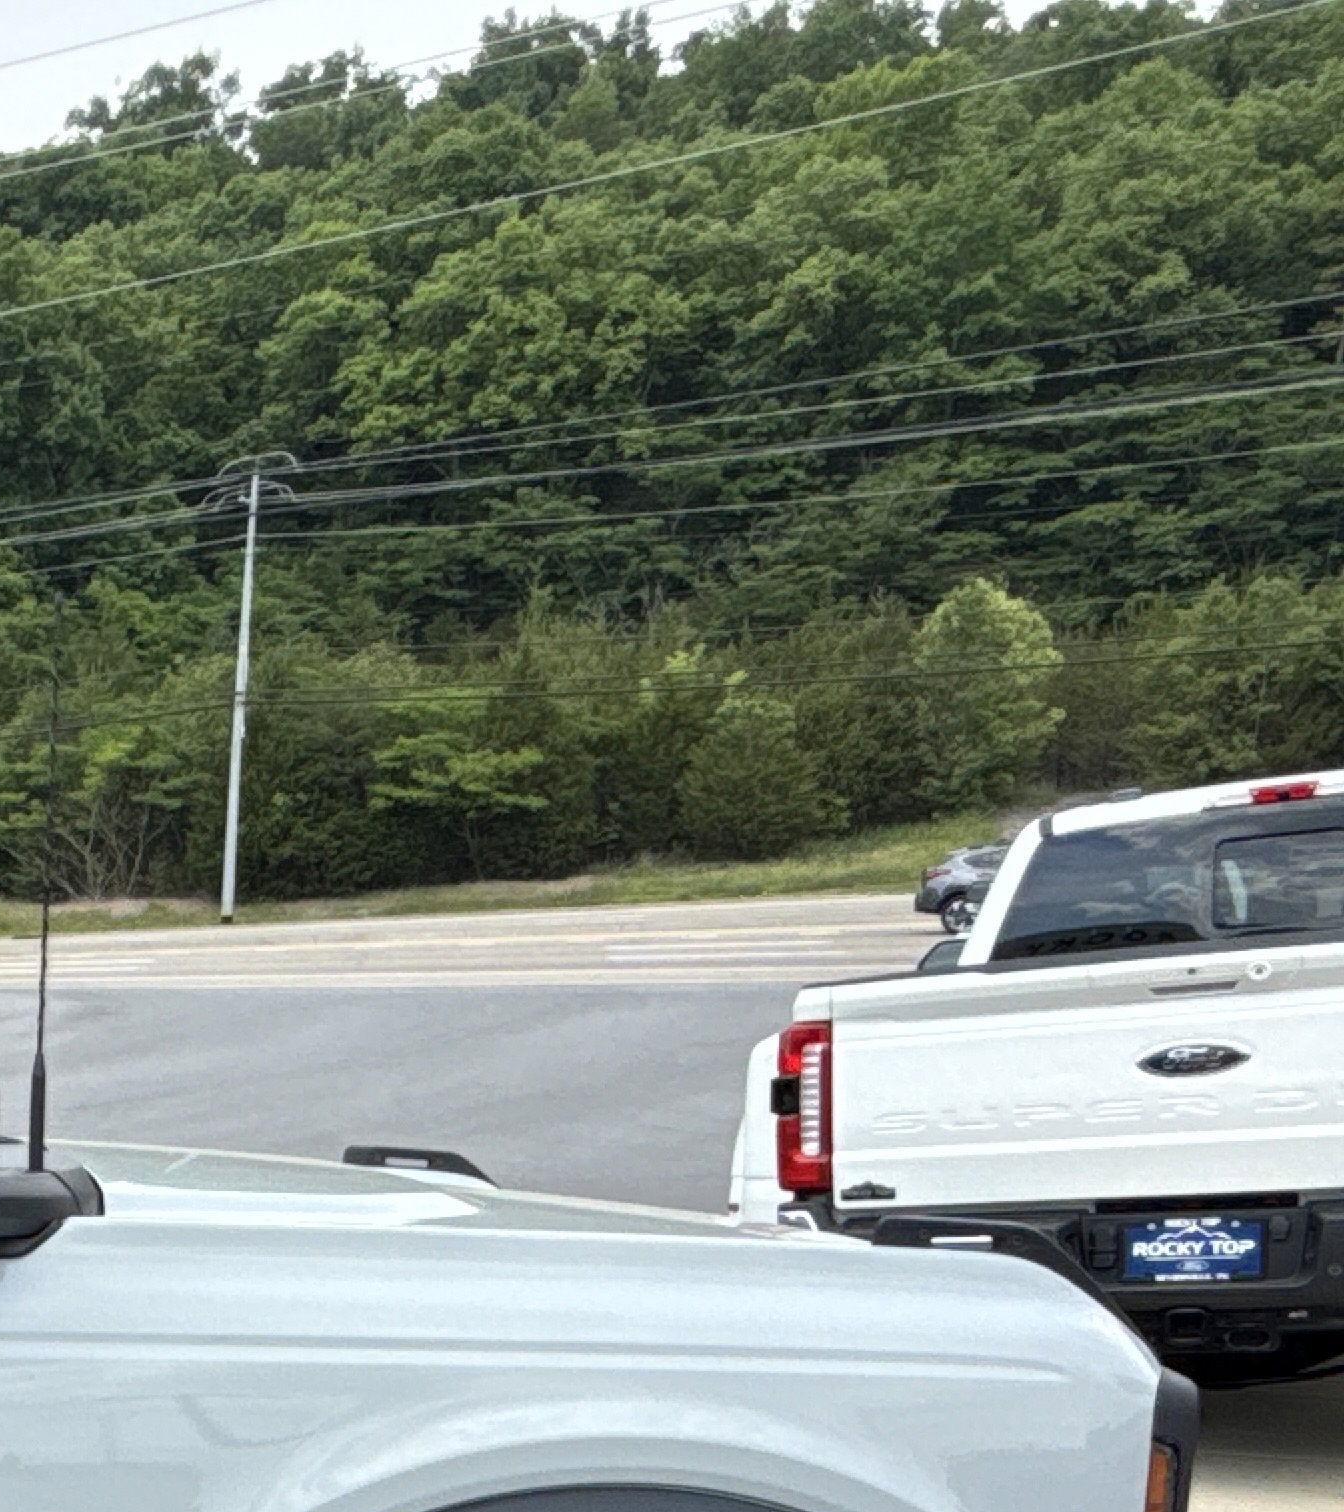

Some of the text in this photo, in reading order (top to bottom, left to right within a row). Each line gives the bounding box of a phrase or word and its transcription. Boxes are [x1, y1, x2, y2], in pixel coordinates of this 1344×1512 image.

[872, 1094, 1220, 1135] SUPER
[1132, 1239, 1256, 1257] ROCKY TOP
